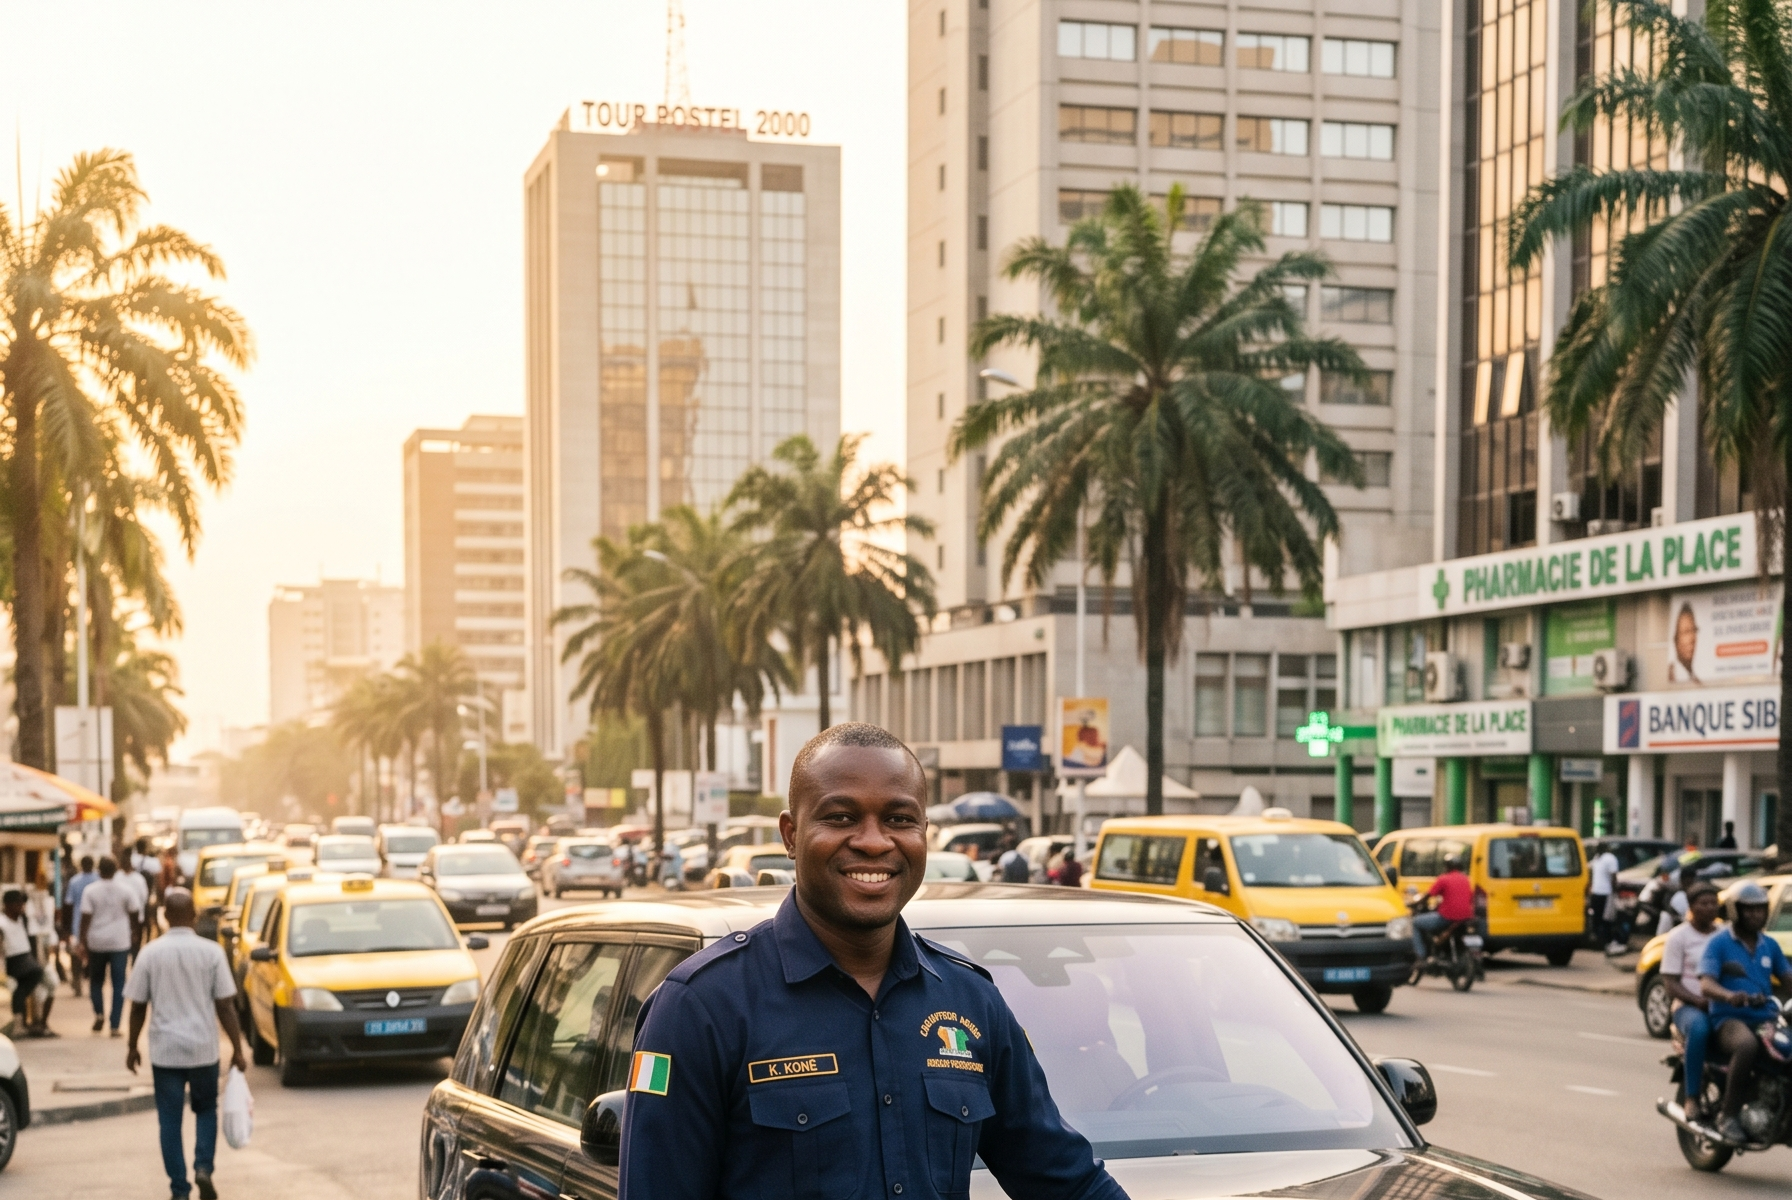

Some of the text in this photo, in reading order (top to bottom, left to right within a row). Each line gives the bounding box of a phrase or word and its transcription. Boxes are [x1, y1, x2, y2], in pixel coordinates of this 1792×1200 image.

[582, 101, 646, 130] TOUR
[756, 110, 811, 137] 2000
[1464, 526, 1741, 603] PHARMACIE DE LA PLACE
[1393, 709, 1526, 735] PHARMACIE DE LA PLACE
[1650, 699, 1777, 737] BANQUE SIB
[769, 1063, 781, 1076] K.
